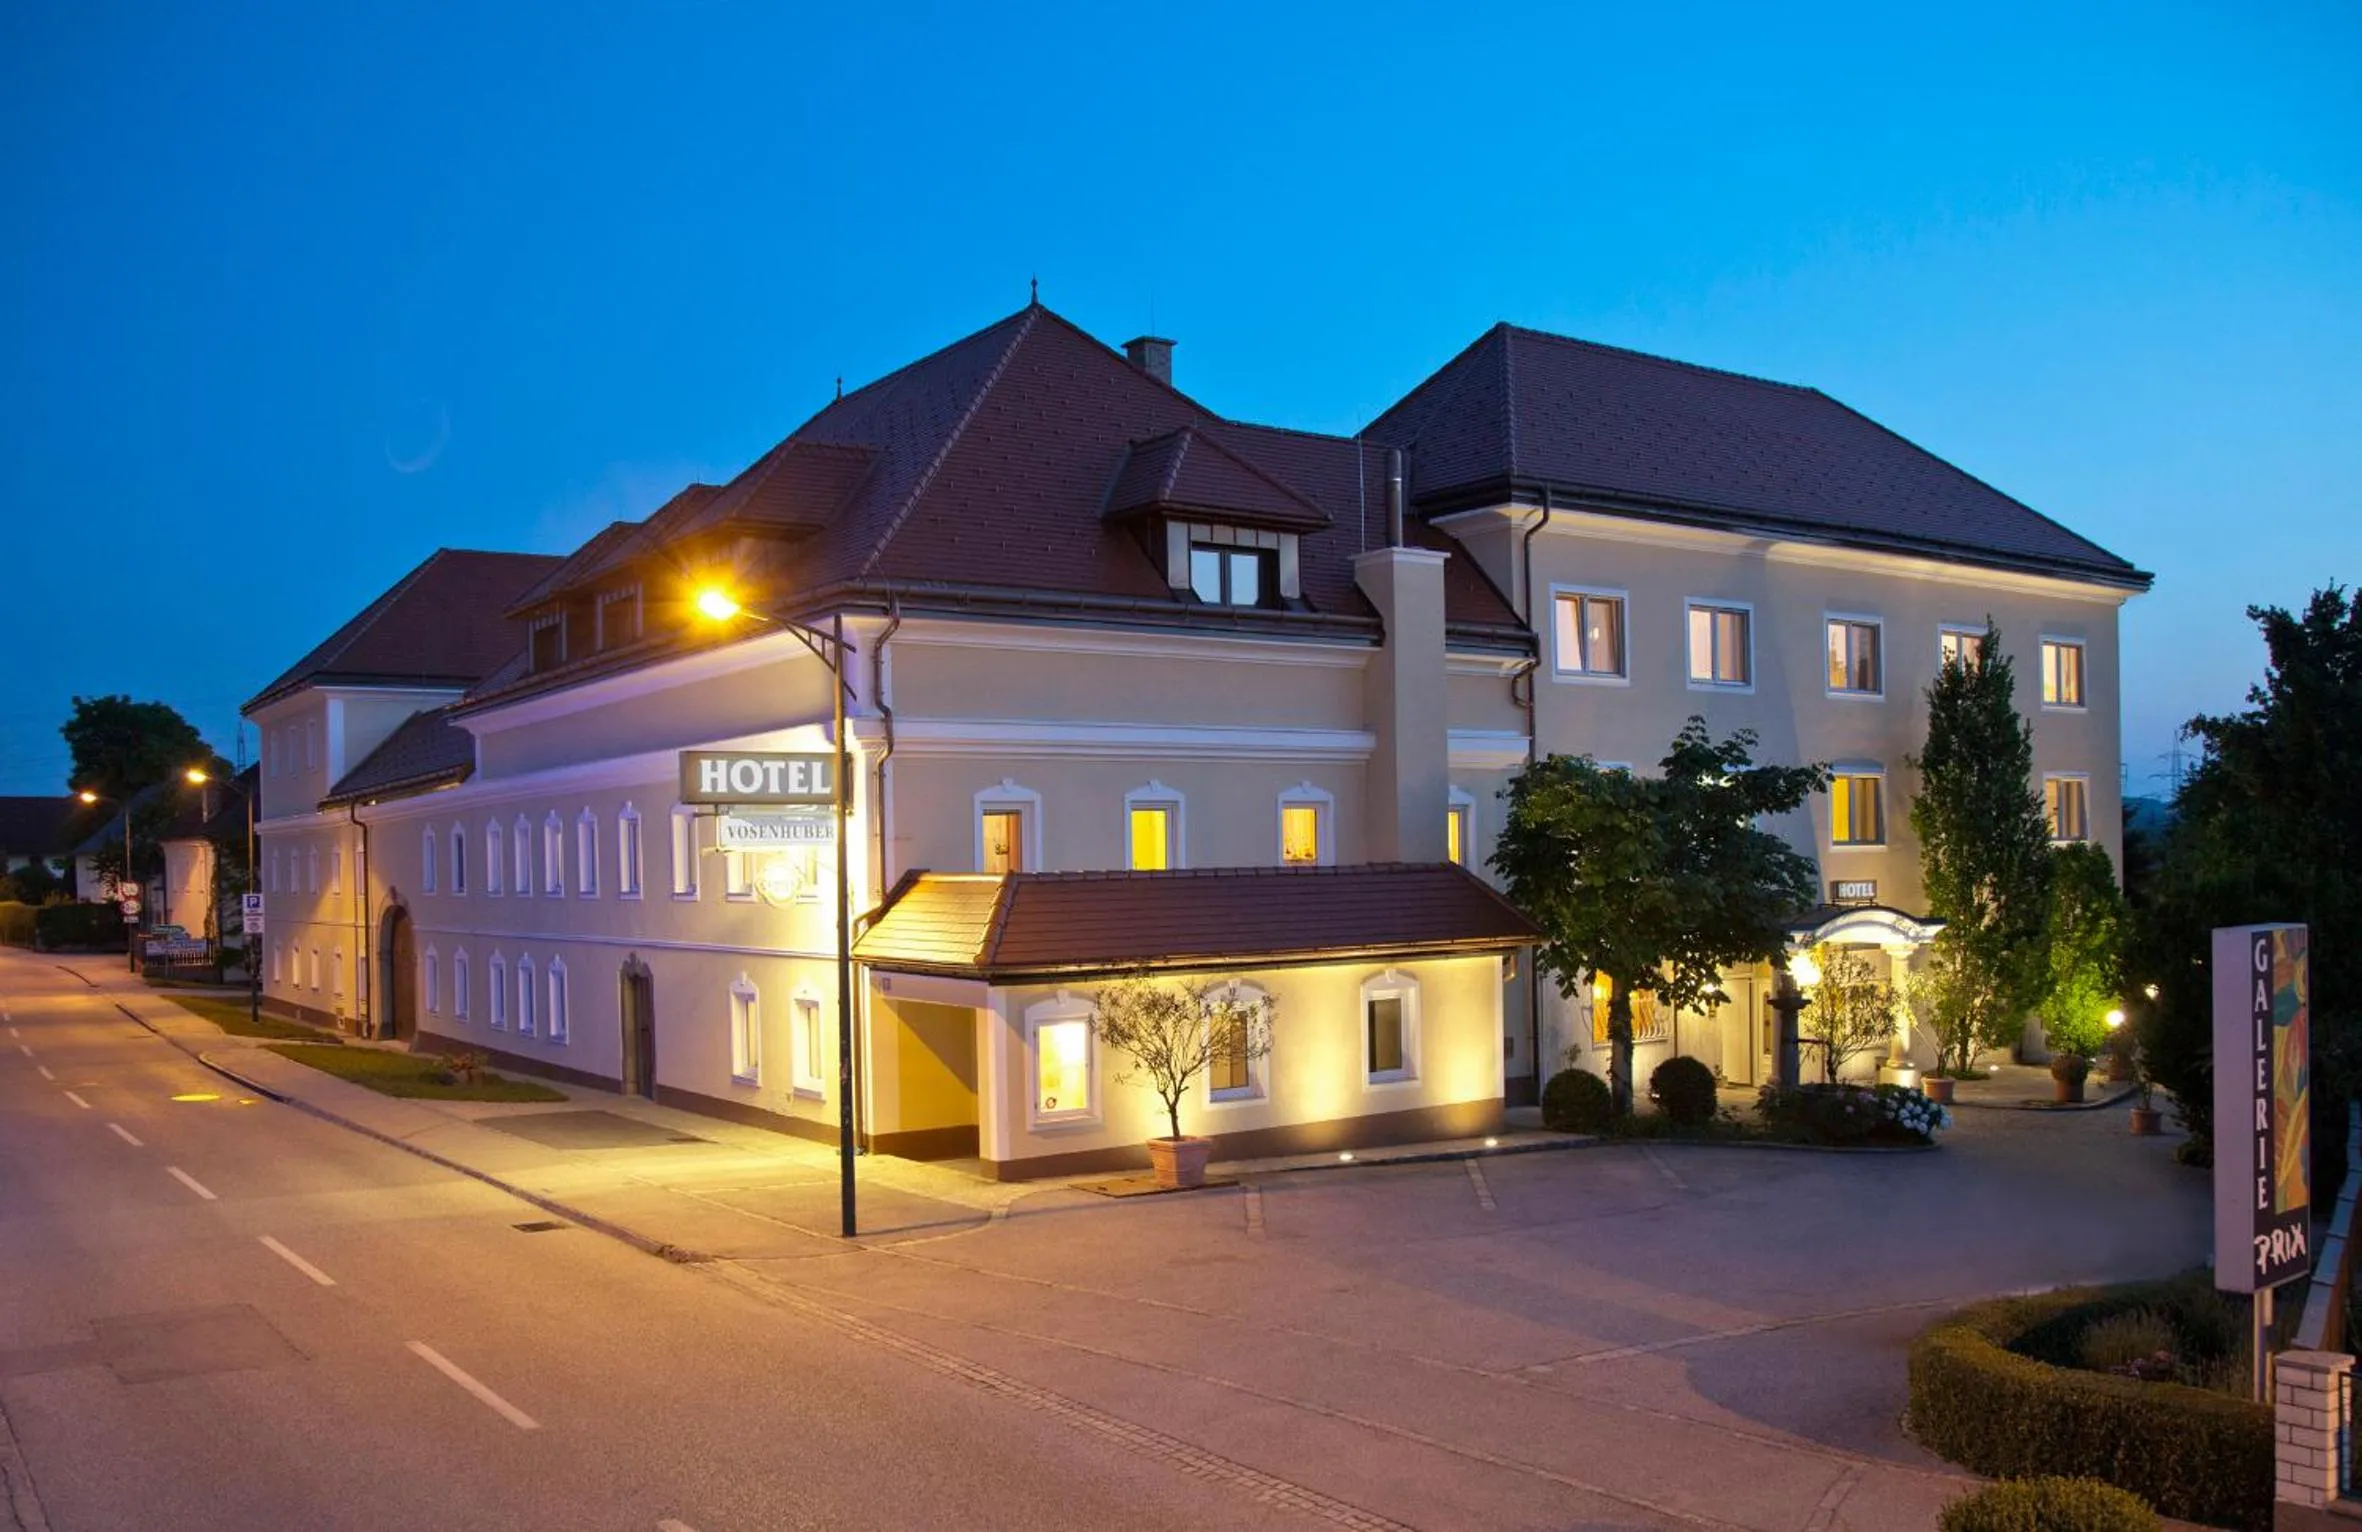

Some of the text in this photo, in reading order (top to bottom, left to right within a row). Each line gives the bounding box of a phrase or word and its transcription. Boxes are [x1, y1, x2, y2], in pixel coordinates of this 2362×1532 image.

[700, 759, 832, 795] HOTEL
[728, 825, 834, 839] VOSENHUBER
[1838, 883, 1874, 898] HOTEL
[2254, 938, 2269, 1210] GALERIE
[2253, 1222, 2306, 1275] PRIX
